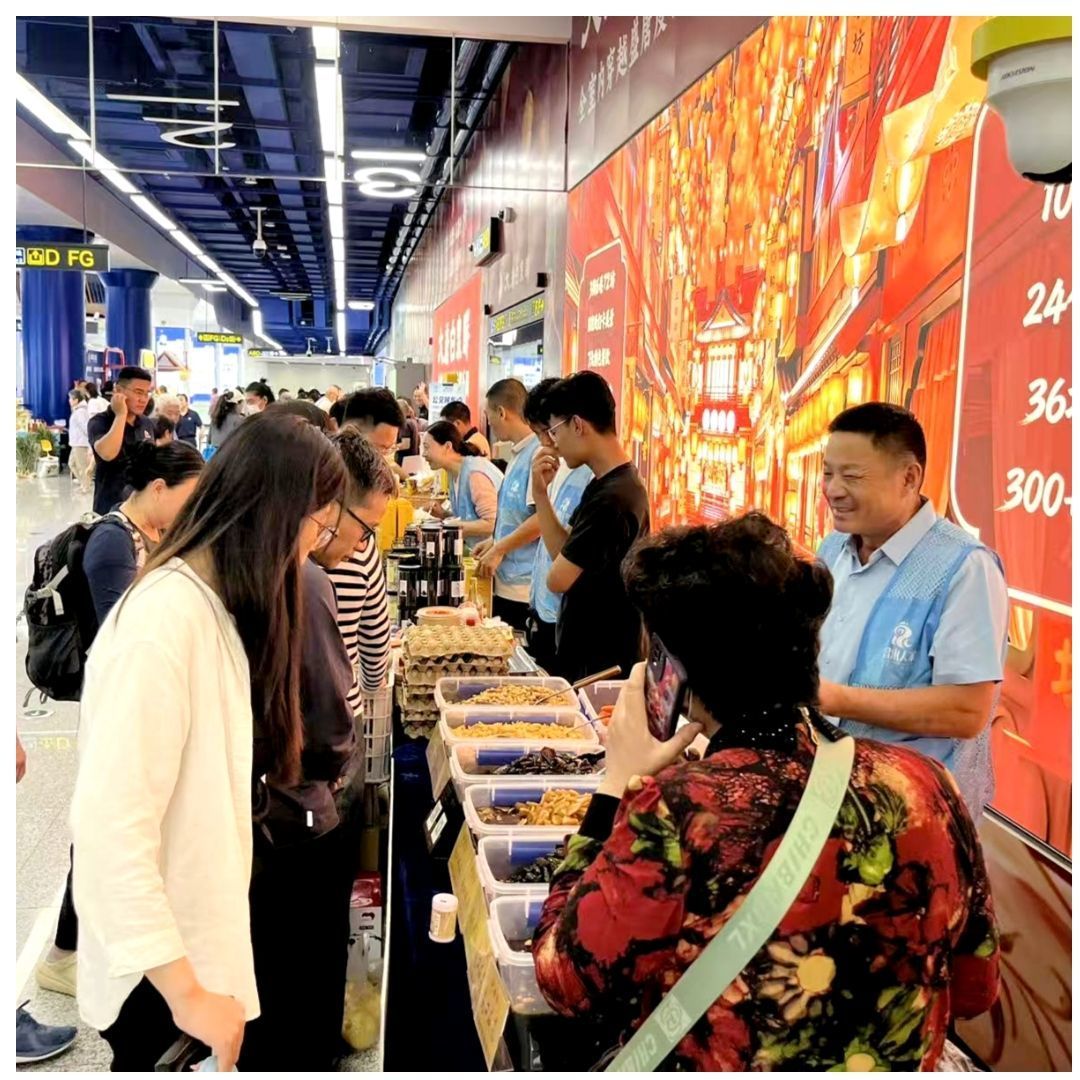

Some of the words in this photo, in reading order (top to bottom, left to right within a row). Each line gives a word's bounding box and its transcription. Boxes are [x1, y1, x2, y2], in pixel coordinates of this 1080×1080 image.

[45, 249, 60, 266] D
[67, 249, 94, 268] FG
[1022, 278, 1072, 328] 24
[1017, 377, 1072, 426] 36
